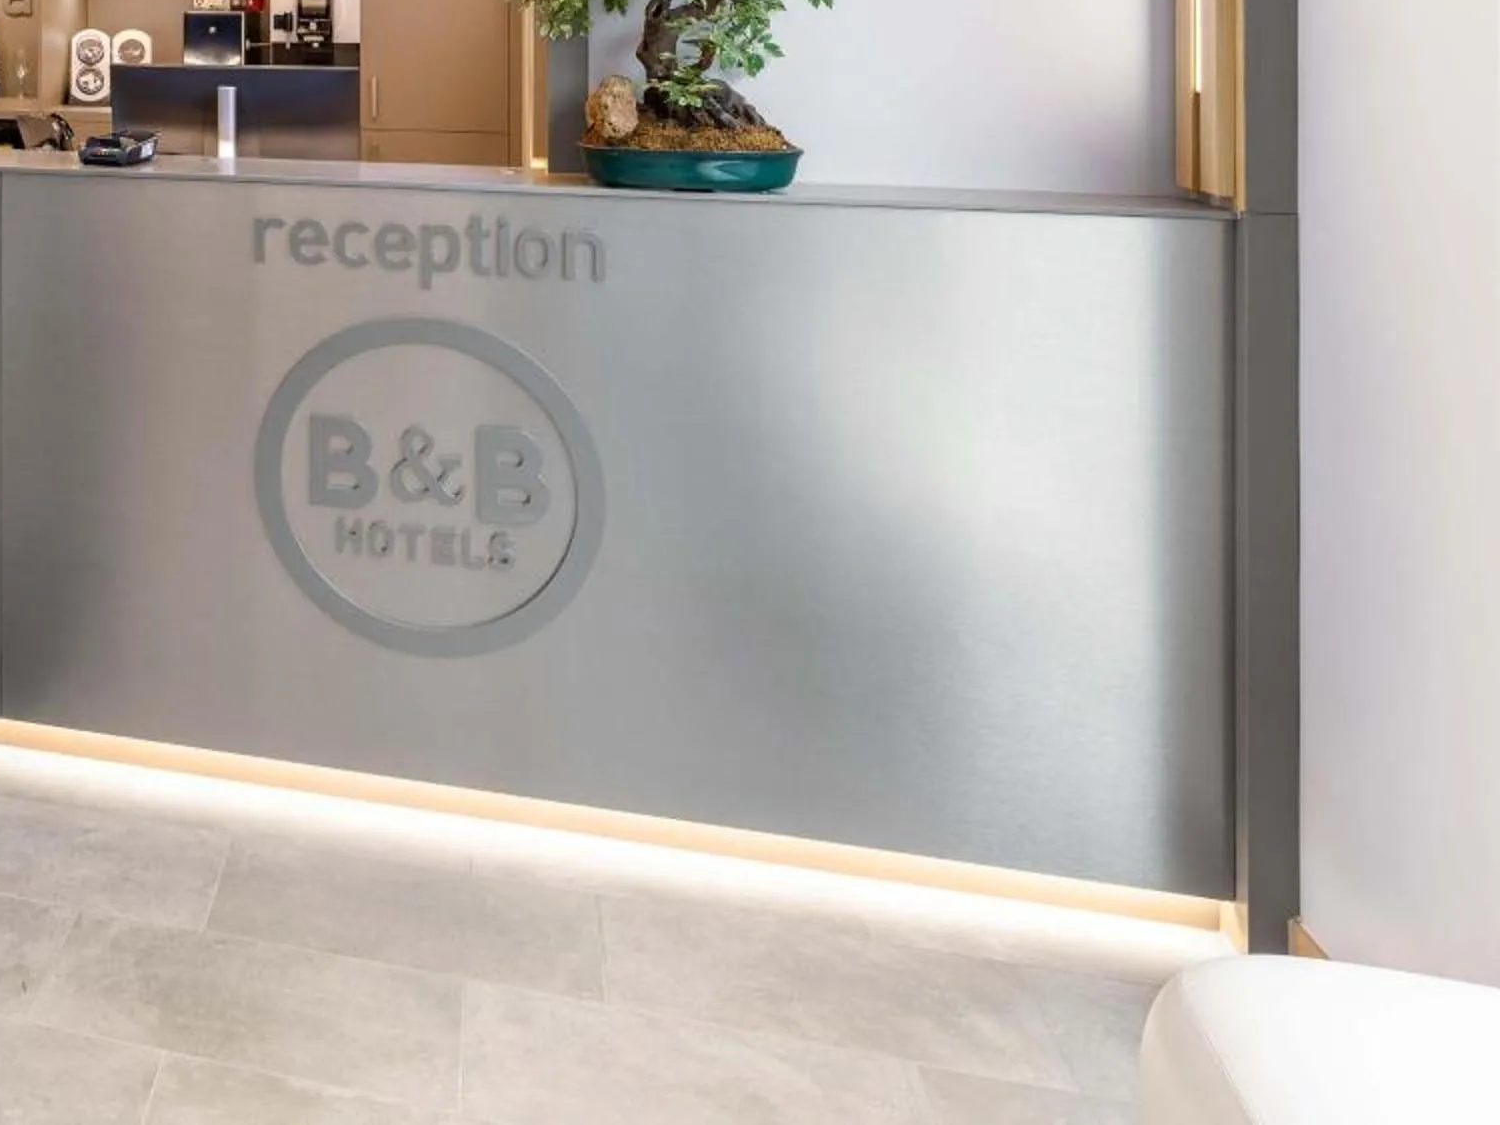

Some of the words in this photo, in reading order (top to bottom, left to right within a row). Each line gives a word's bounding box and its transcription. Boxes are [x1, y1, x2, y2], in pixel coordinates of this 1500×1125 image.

[252, 214, 606, 291] reception
[308, 411, 551, 528] B&B
[334, 514, 515, 572] HOTELS
